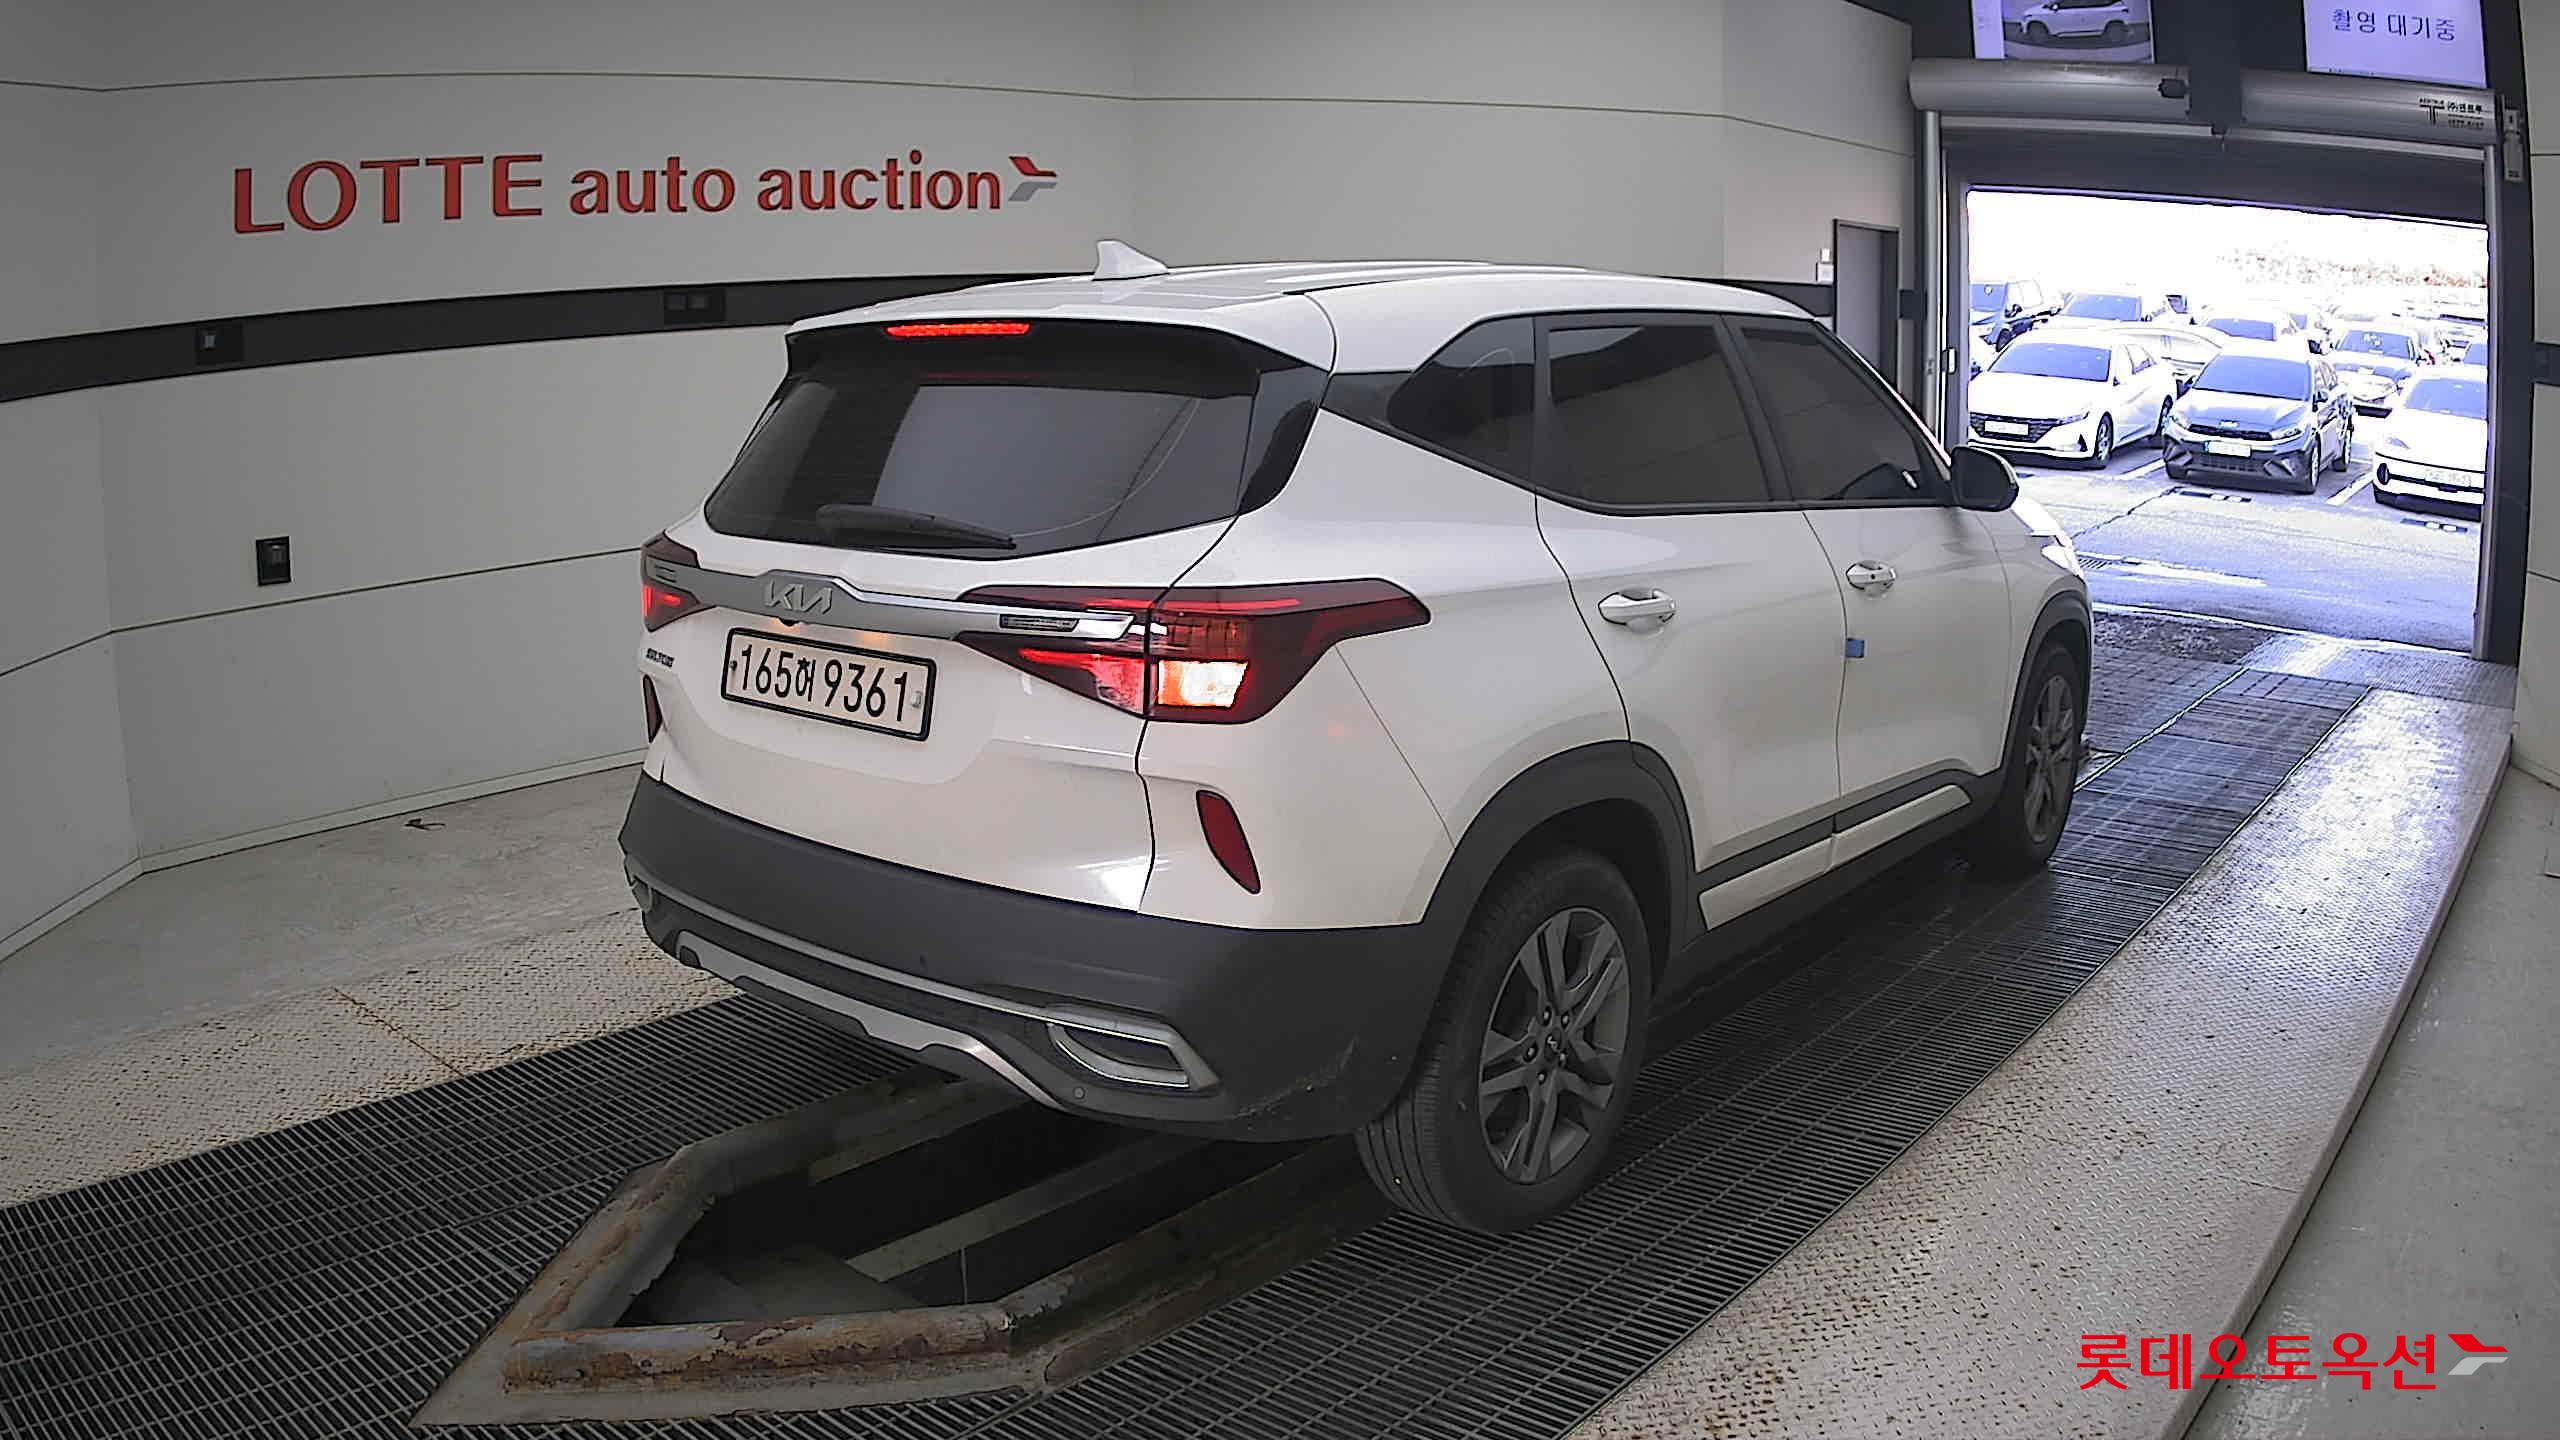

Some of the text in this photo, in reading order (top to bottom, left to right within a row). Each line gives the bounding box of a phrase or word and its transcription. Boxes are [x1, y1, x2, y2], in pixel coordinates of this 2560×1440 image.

[2332, 8, 2455, 41] 촬영 대기중
[234, 150, 1001, 234] LOTTE auto auction
